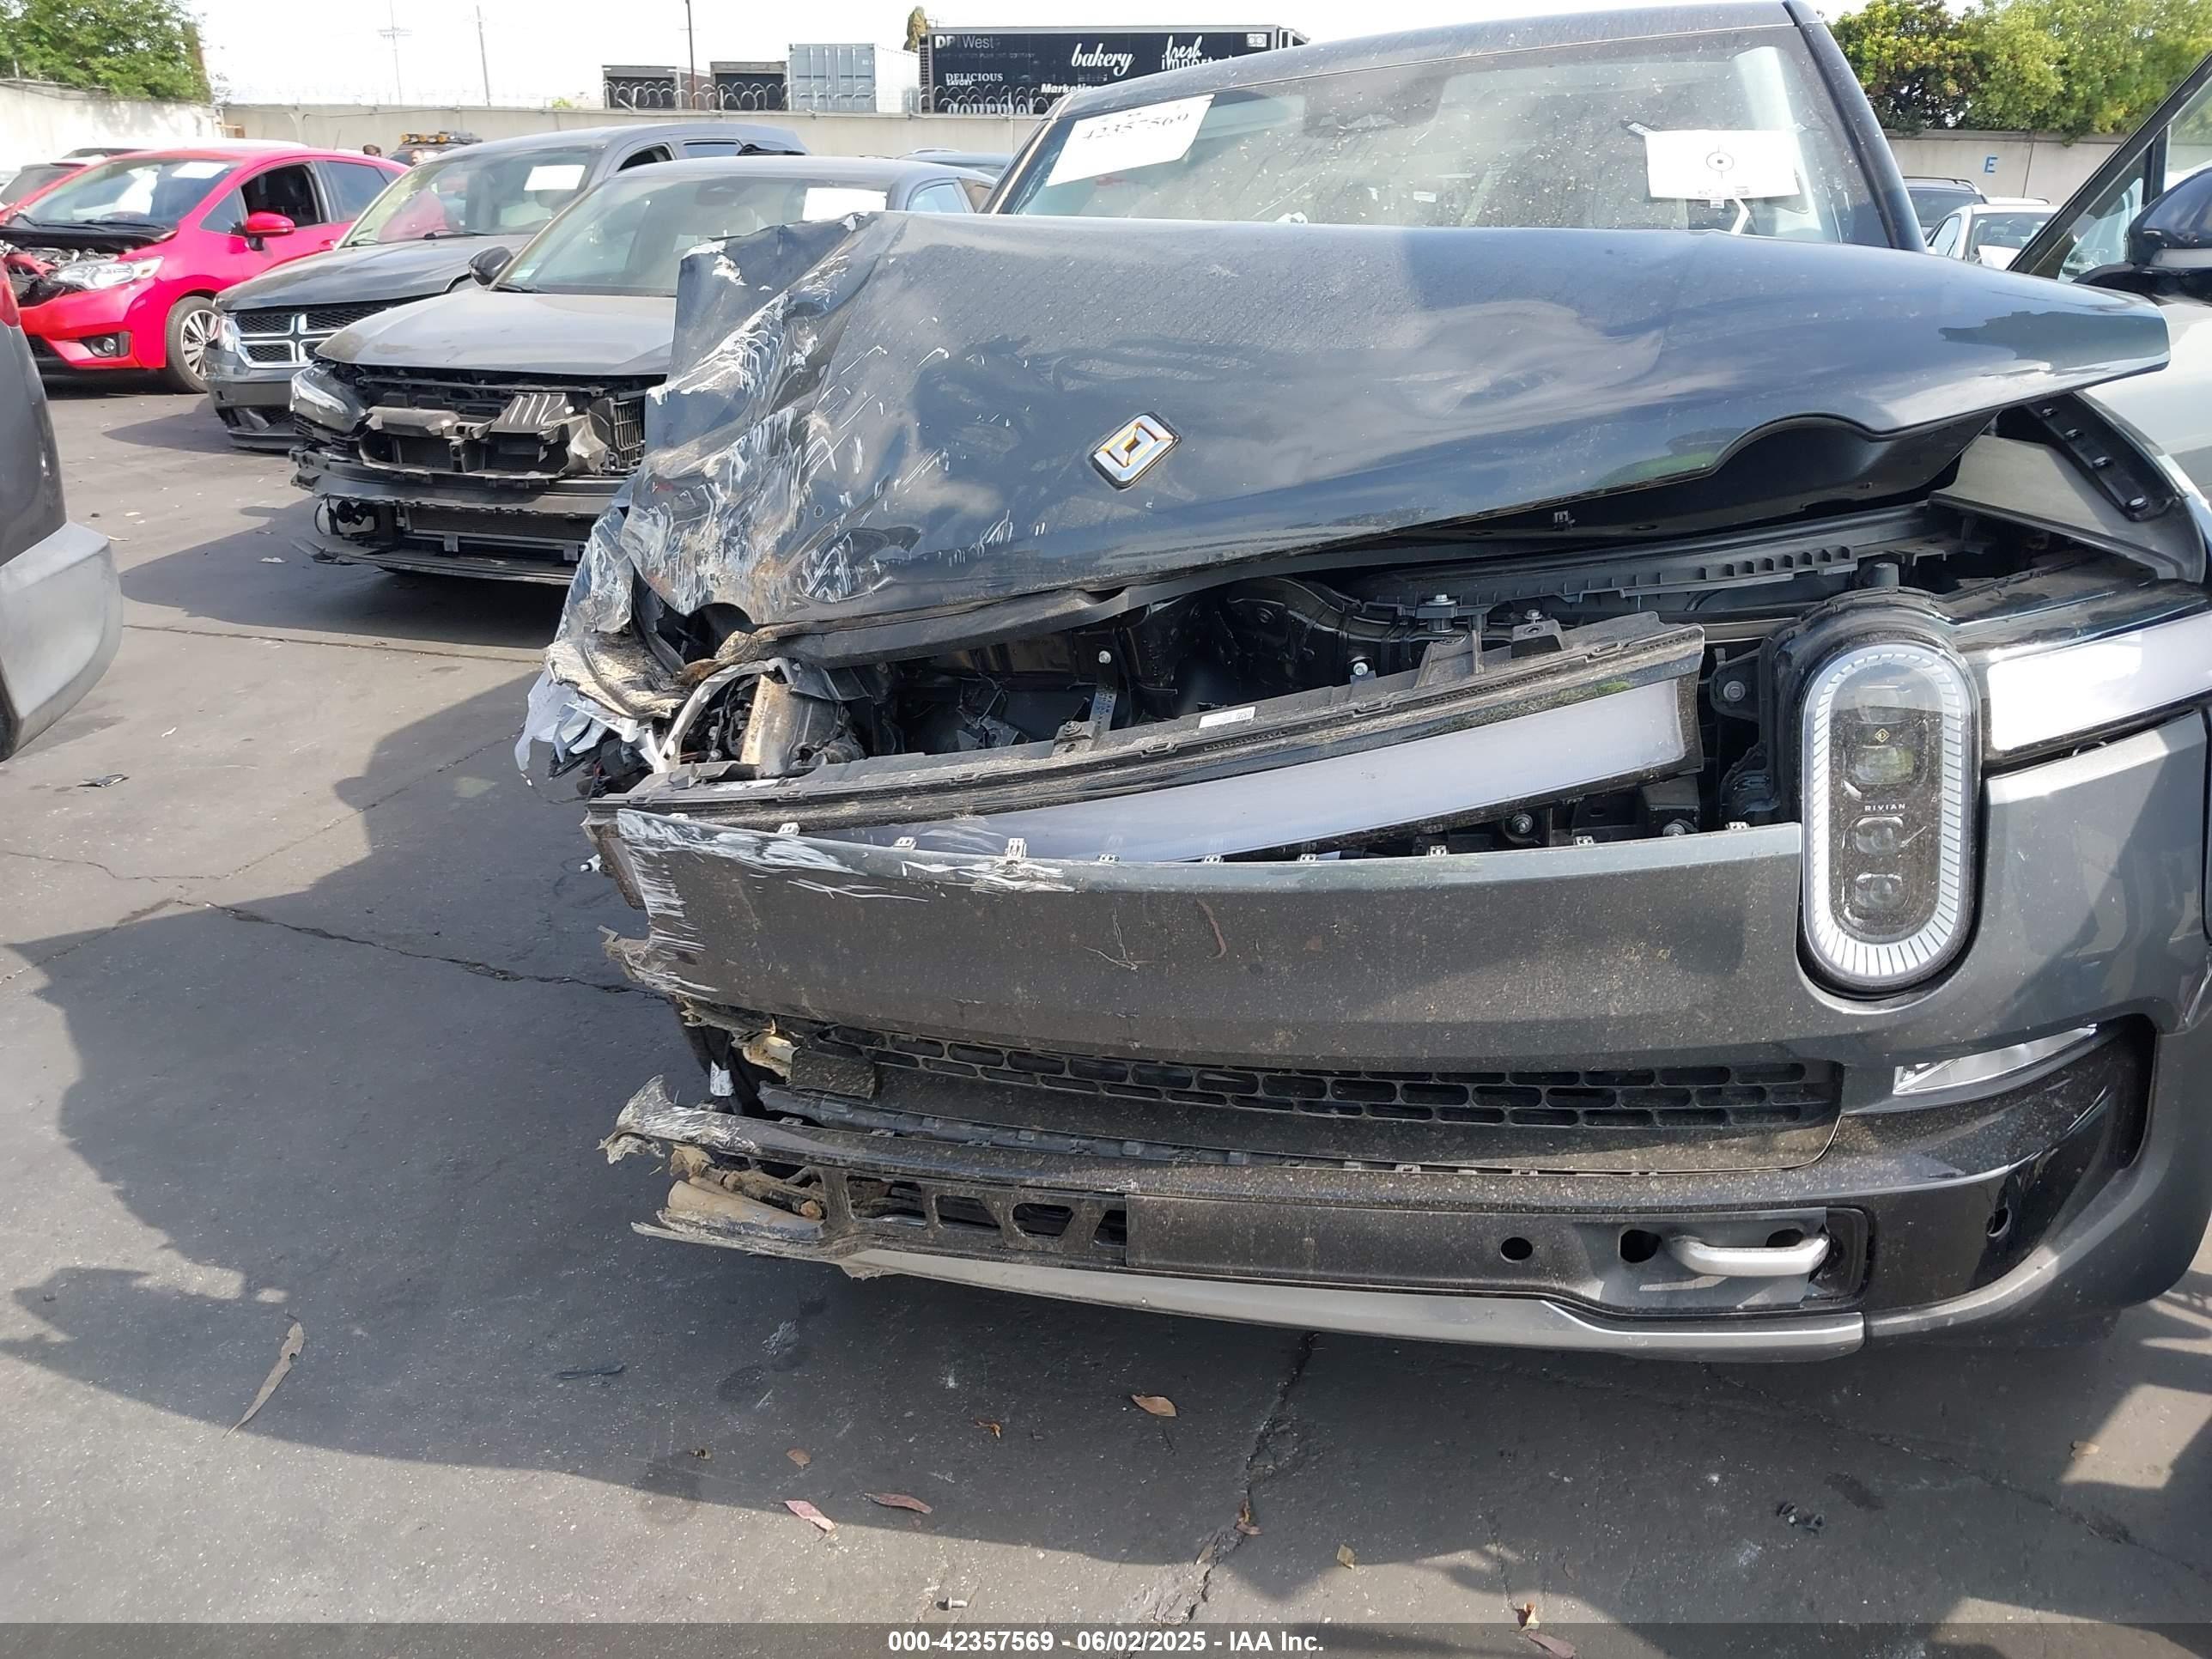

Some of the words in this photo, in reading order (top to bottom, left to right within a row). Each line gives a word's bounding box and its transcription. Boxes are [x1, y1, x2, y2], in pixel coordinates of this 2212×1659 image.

[962, 35, 994, 49] West
[1071, 42, 1136, 76] bakery
[1164, 34, 1203, 70] fresh
[945, 72, 1004, 82] DELICIOUS
[1984, 155, 1999, 173] E
[1863, 803, 1906, 812] RIVIAN
